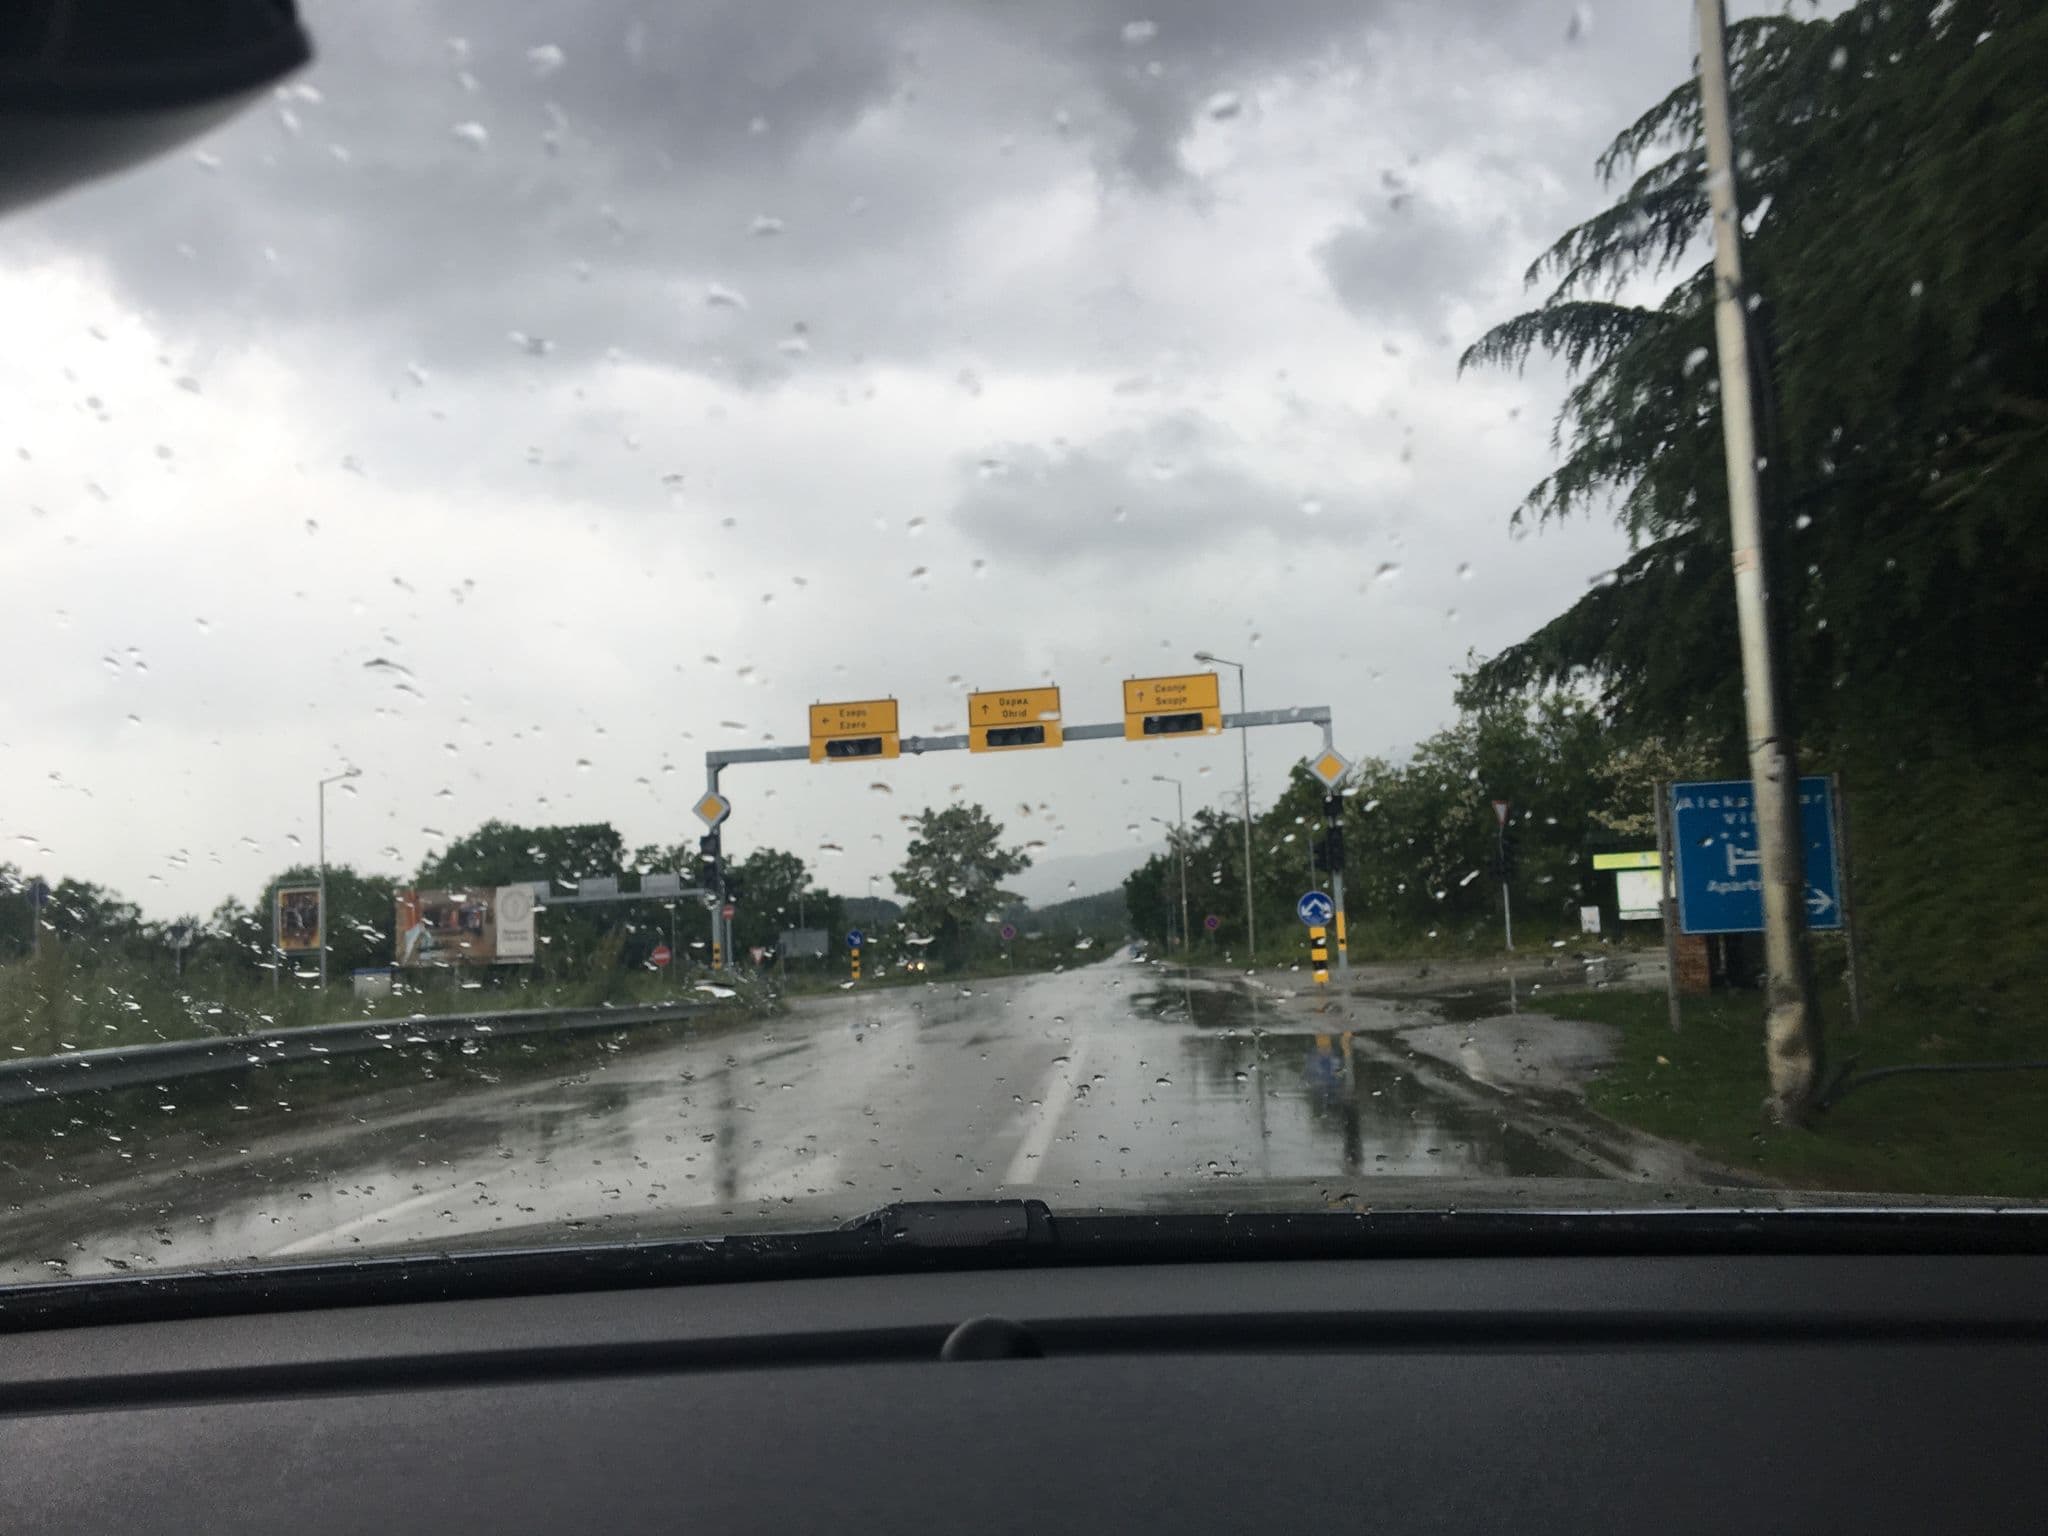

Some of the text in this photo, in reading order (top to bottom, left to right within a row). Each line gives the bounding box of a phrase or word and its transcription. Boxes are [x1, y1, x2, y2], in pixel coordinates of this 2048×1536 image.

[1155, 696, 1187, 706] Skopje
[1002, 708, 1028, 718] Ohrid
[1678, 793, 1824, 809] Aleksar
